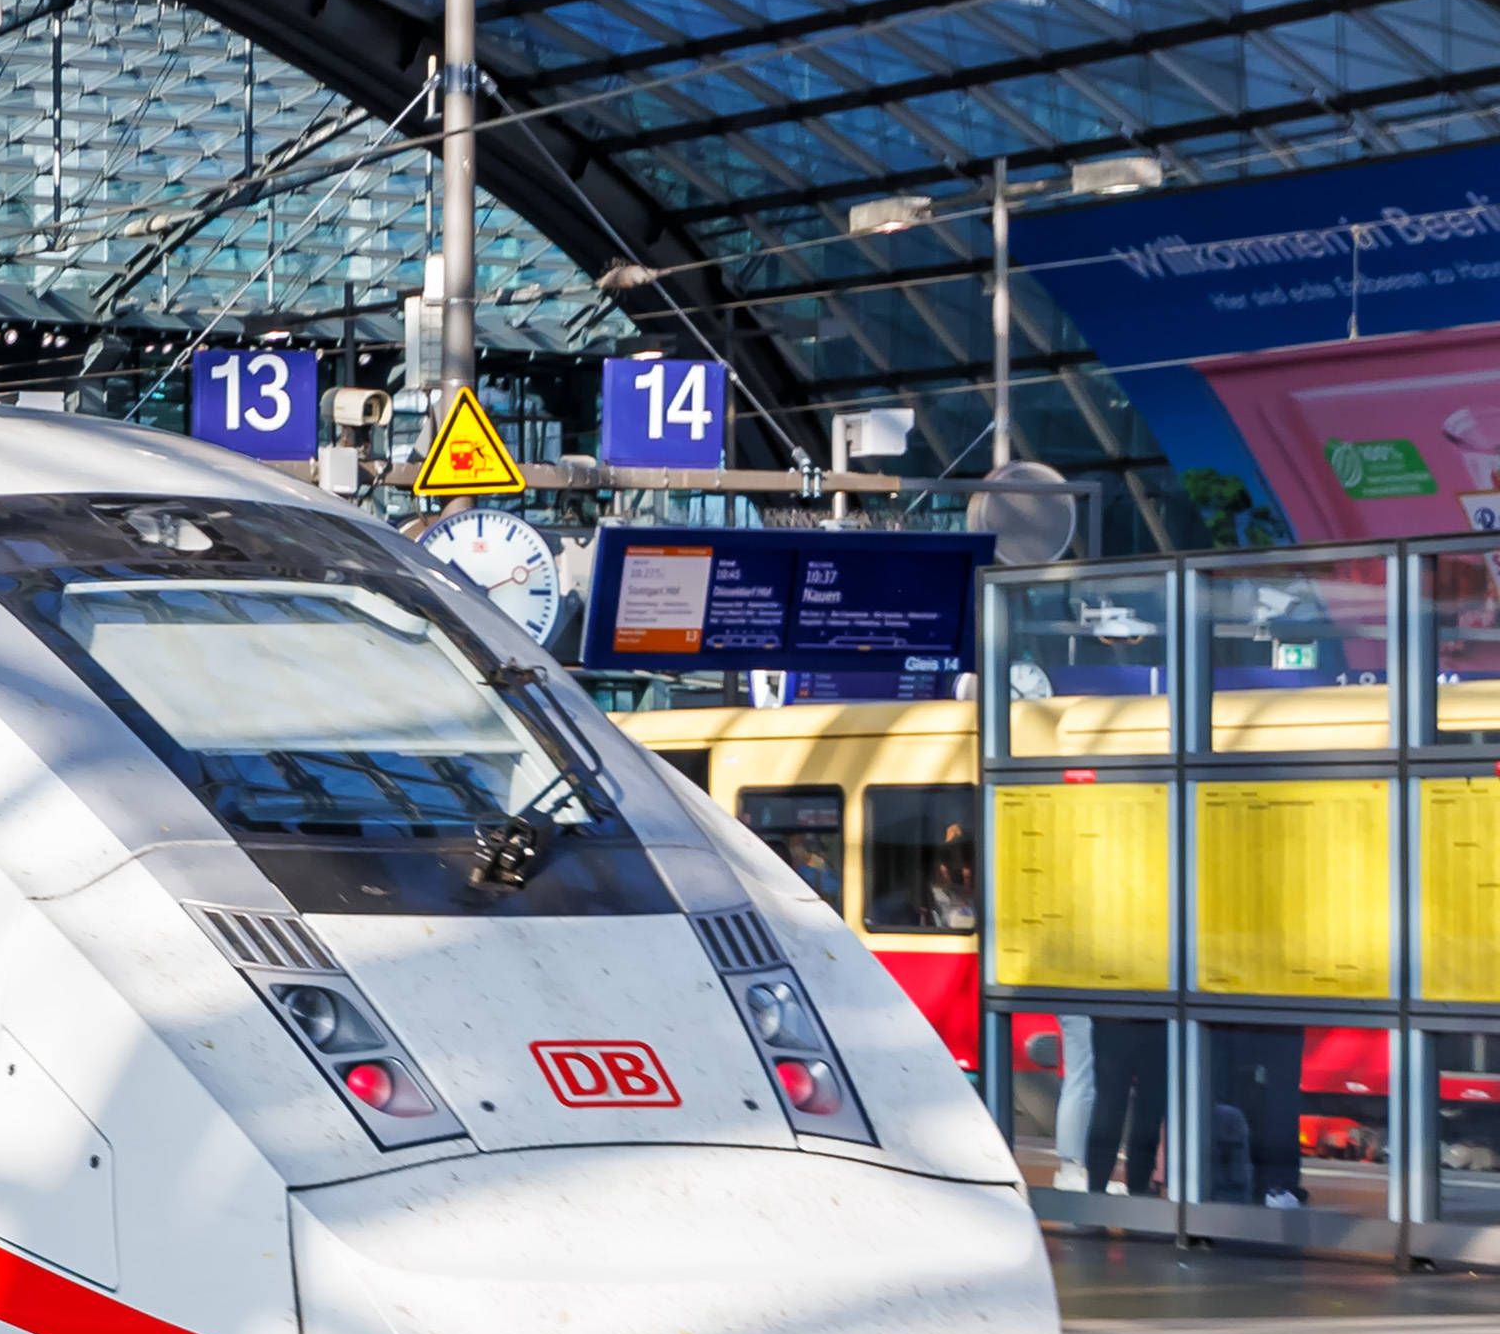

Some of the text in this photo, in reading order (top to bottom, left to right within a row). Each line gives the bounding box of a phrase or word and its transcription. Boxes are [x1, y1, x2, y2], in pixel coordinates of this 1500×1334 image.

[1111, 229, 1349, 278] Willkommen
[210, 355, 291, 432] 13
[634, 364, 713, 441] 14
[802, 588, 842, 603] Nauen
[904, 656, 960, 672] Gleis 14
